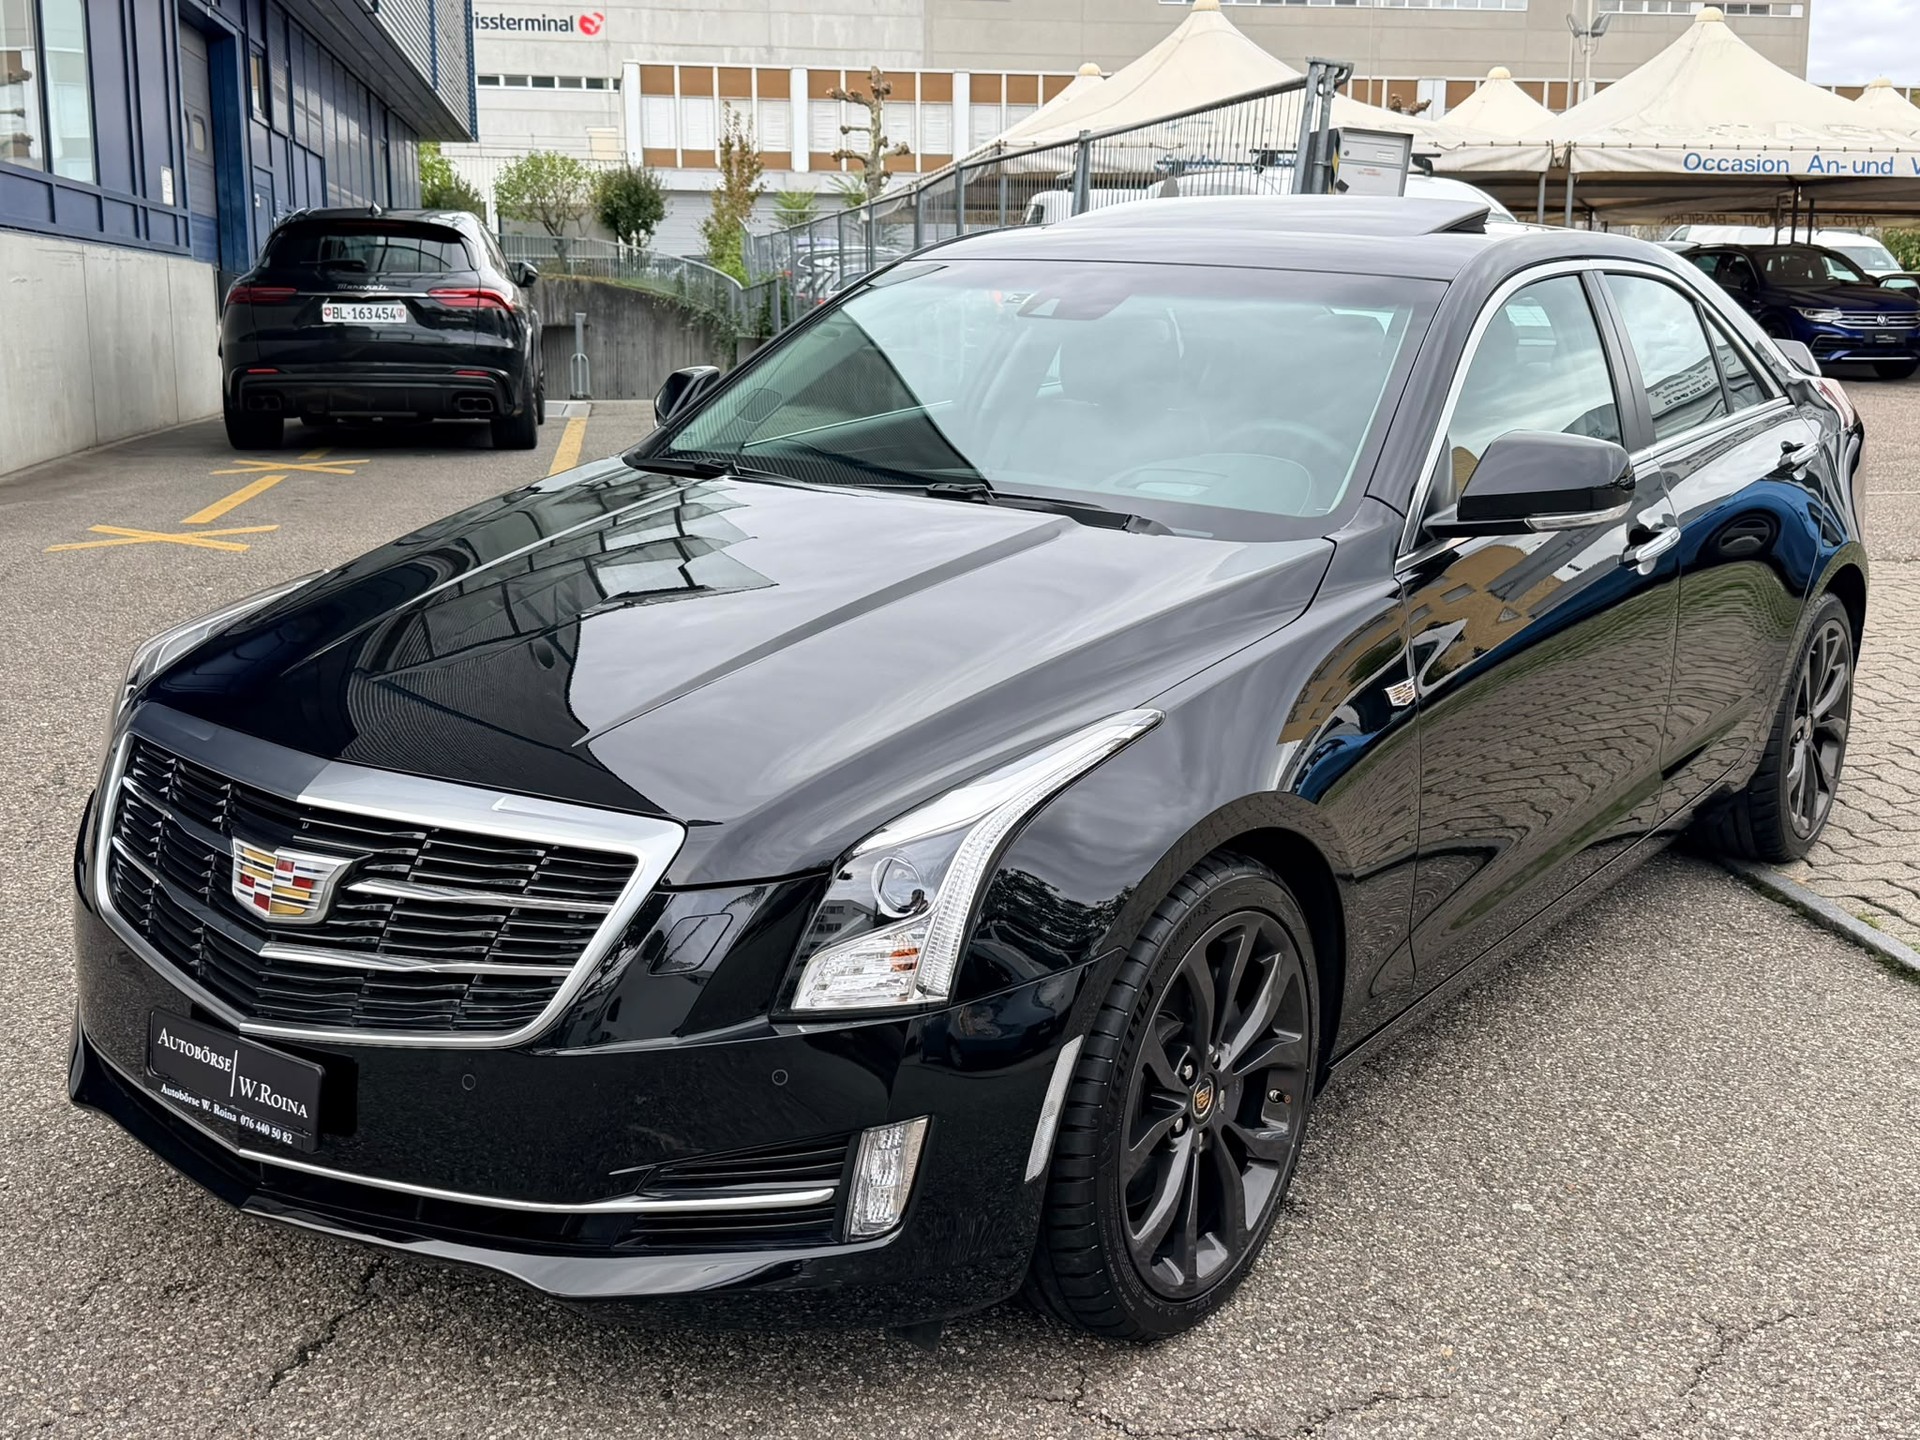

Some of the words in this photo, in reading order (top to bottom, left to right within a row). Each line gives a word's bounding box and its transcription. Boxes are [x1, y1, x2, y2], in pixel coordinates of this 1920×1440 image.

[472, 11, 574, 32] issterminal
[1683, 152, 1790, 174] Occasion
[1807, 154, 1847, 174] An-
[1852, 156, 1894, 175] und
[161, 1083, 200, 1107] Autobörse
[201, 1098, 212, 1112] W.
[213, 1104, 237, 1122] Roina
[240, 1114, 255, 1129] 076
[255, 1118, 270, 1135] 440
[271, 1126, 281, 1140] 50
[282, 1131, 293, 1144] 82
